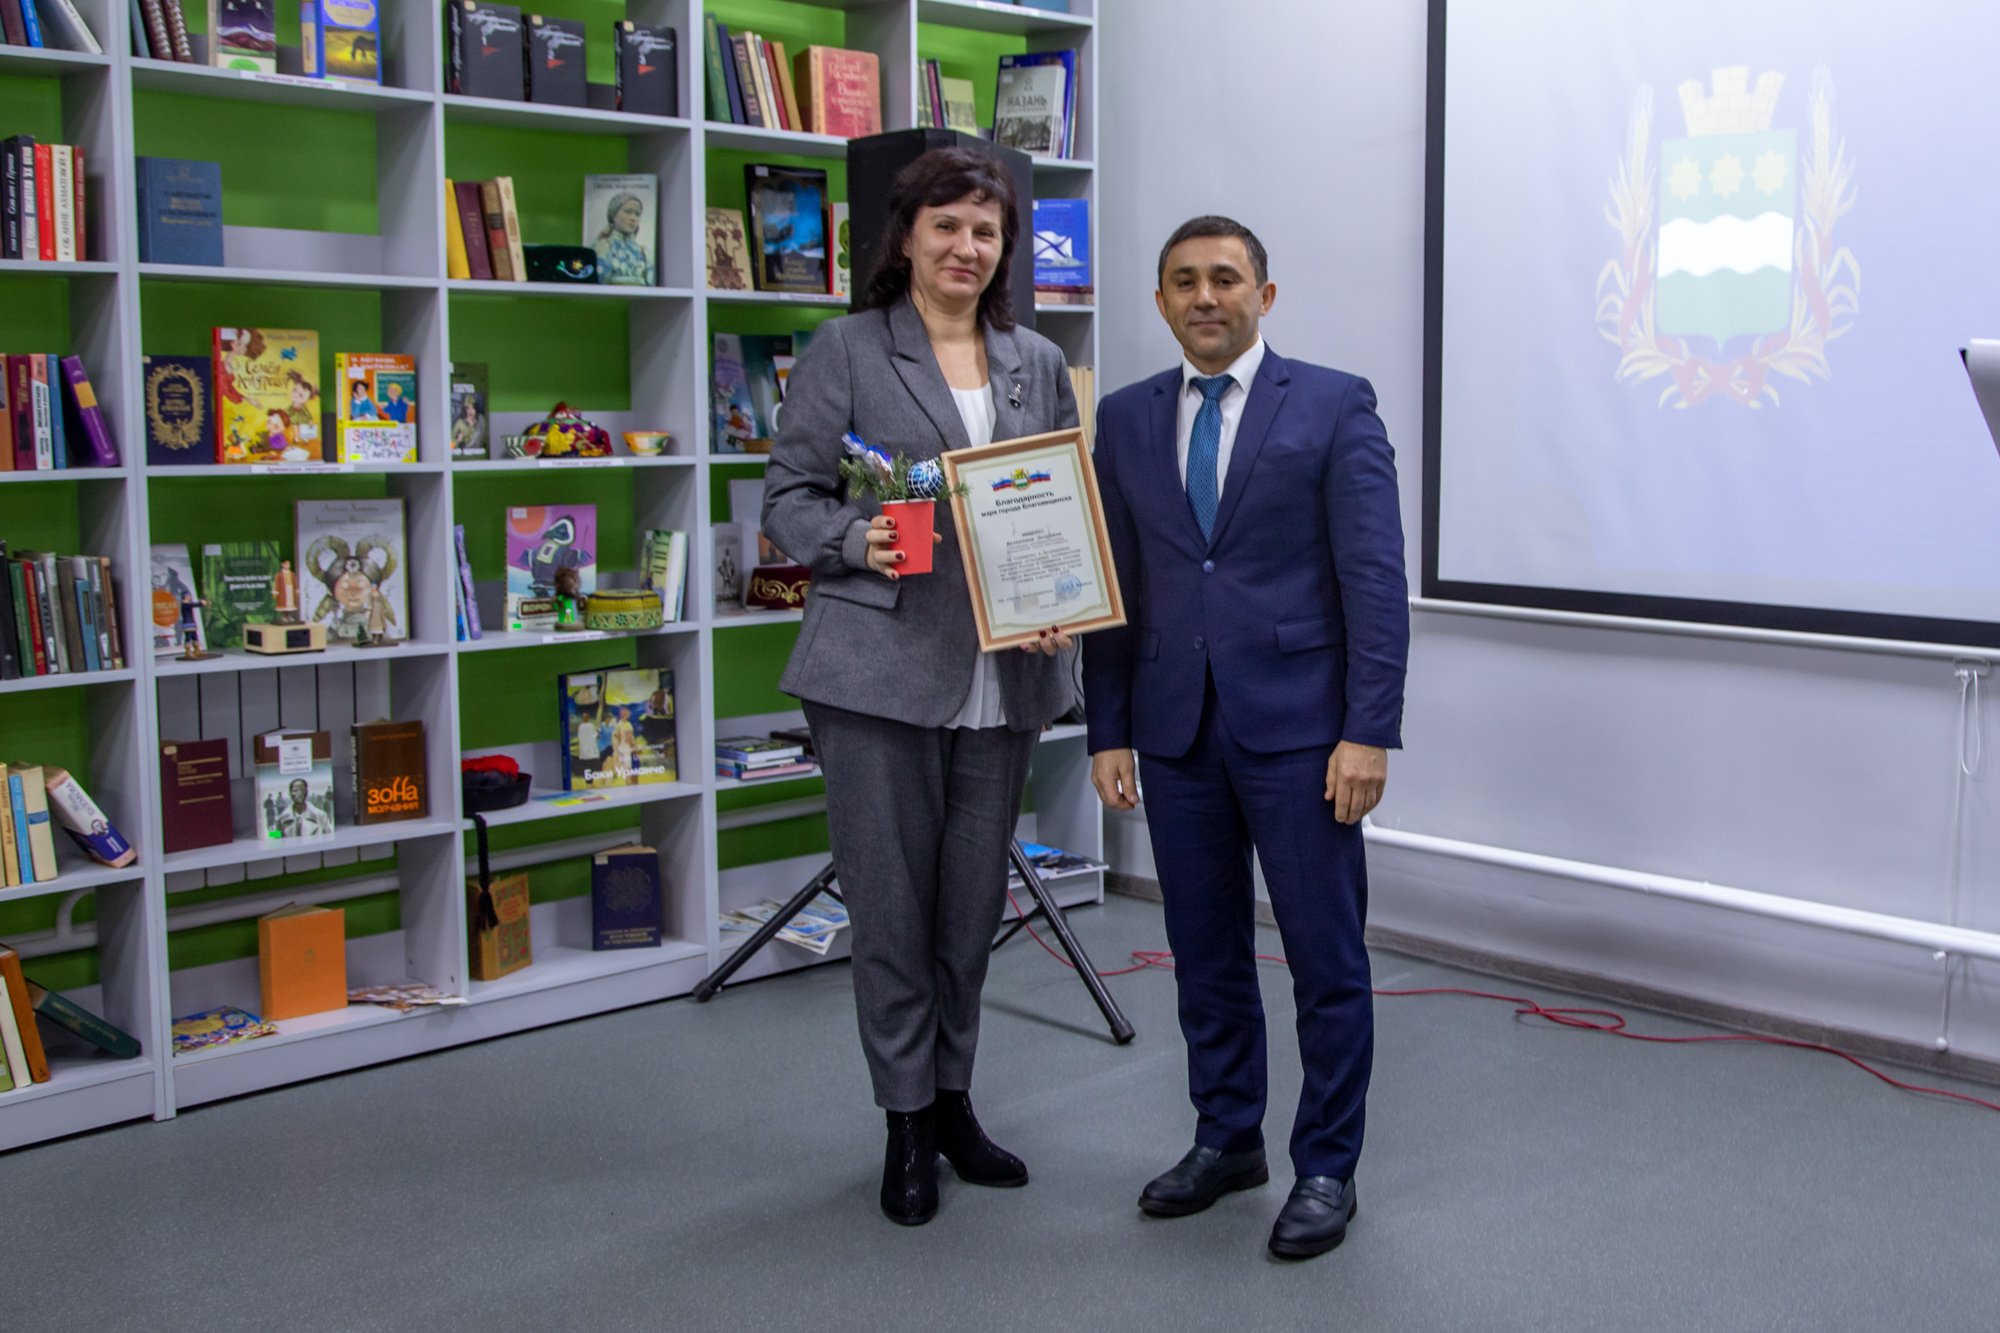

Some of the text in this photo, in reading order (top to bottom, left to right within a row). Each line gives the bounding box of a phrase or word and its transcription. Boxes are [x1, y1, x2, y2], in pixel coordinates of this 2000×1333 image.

[1007, 95, 1048, 107] КАЗАНЬ
[995, 490, 1055, 508] Благодарность
[583, 764, 666, 783] Баки Урманче
